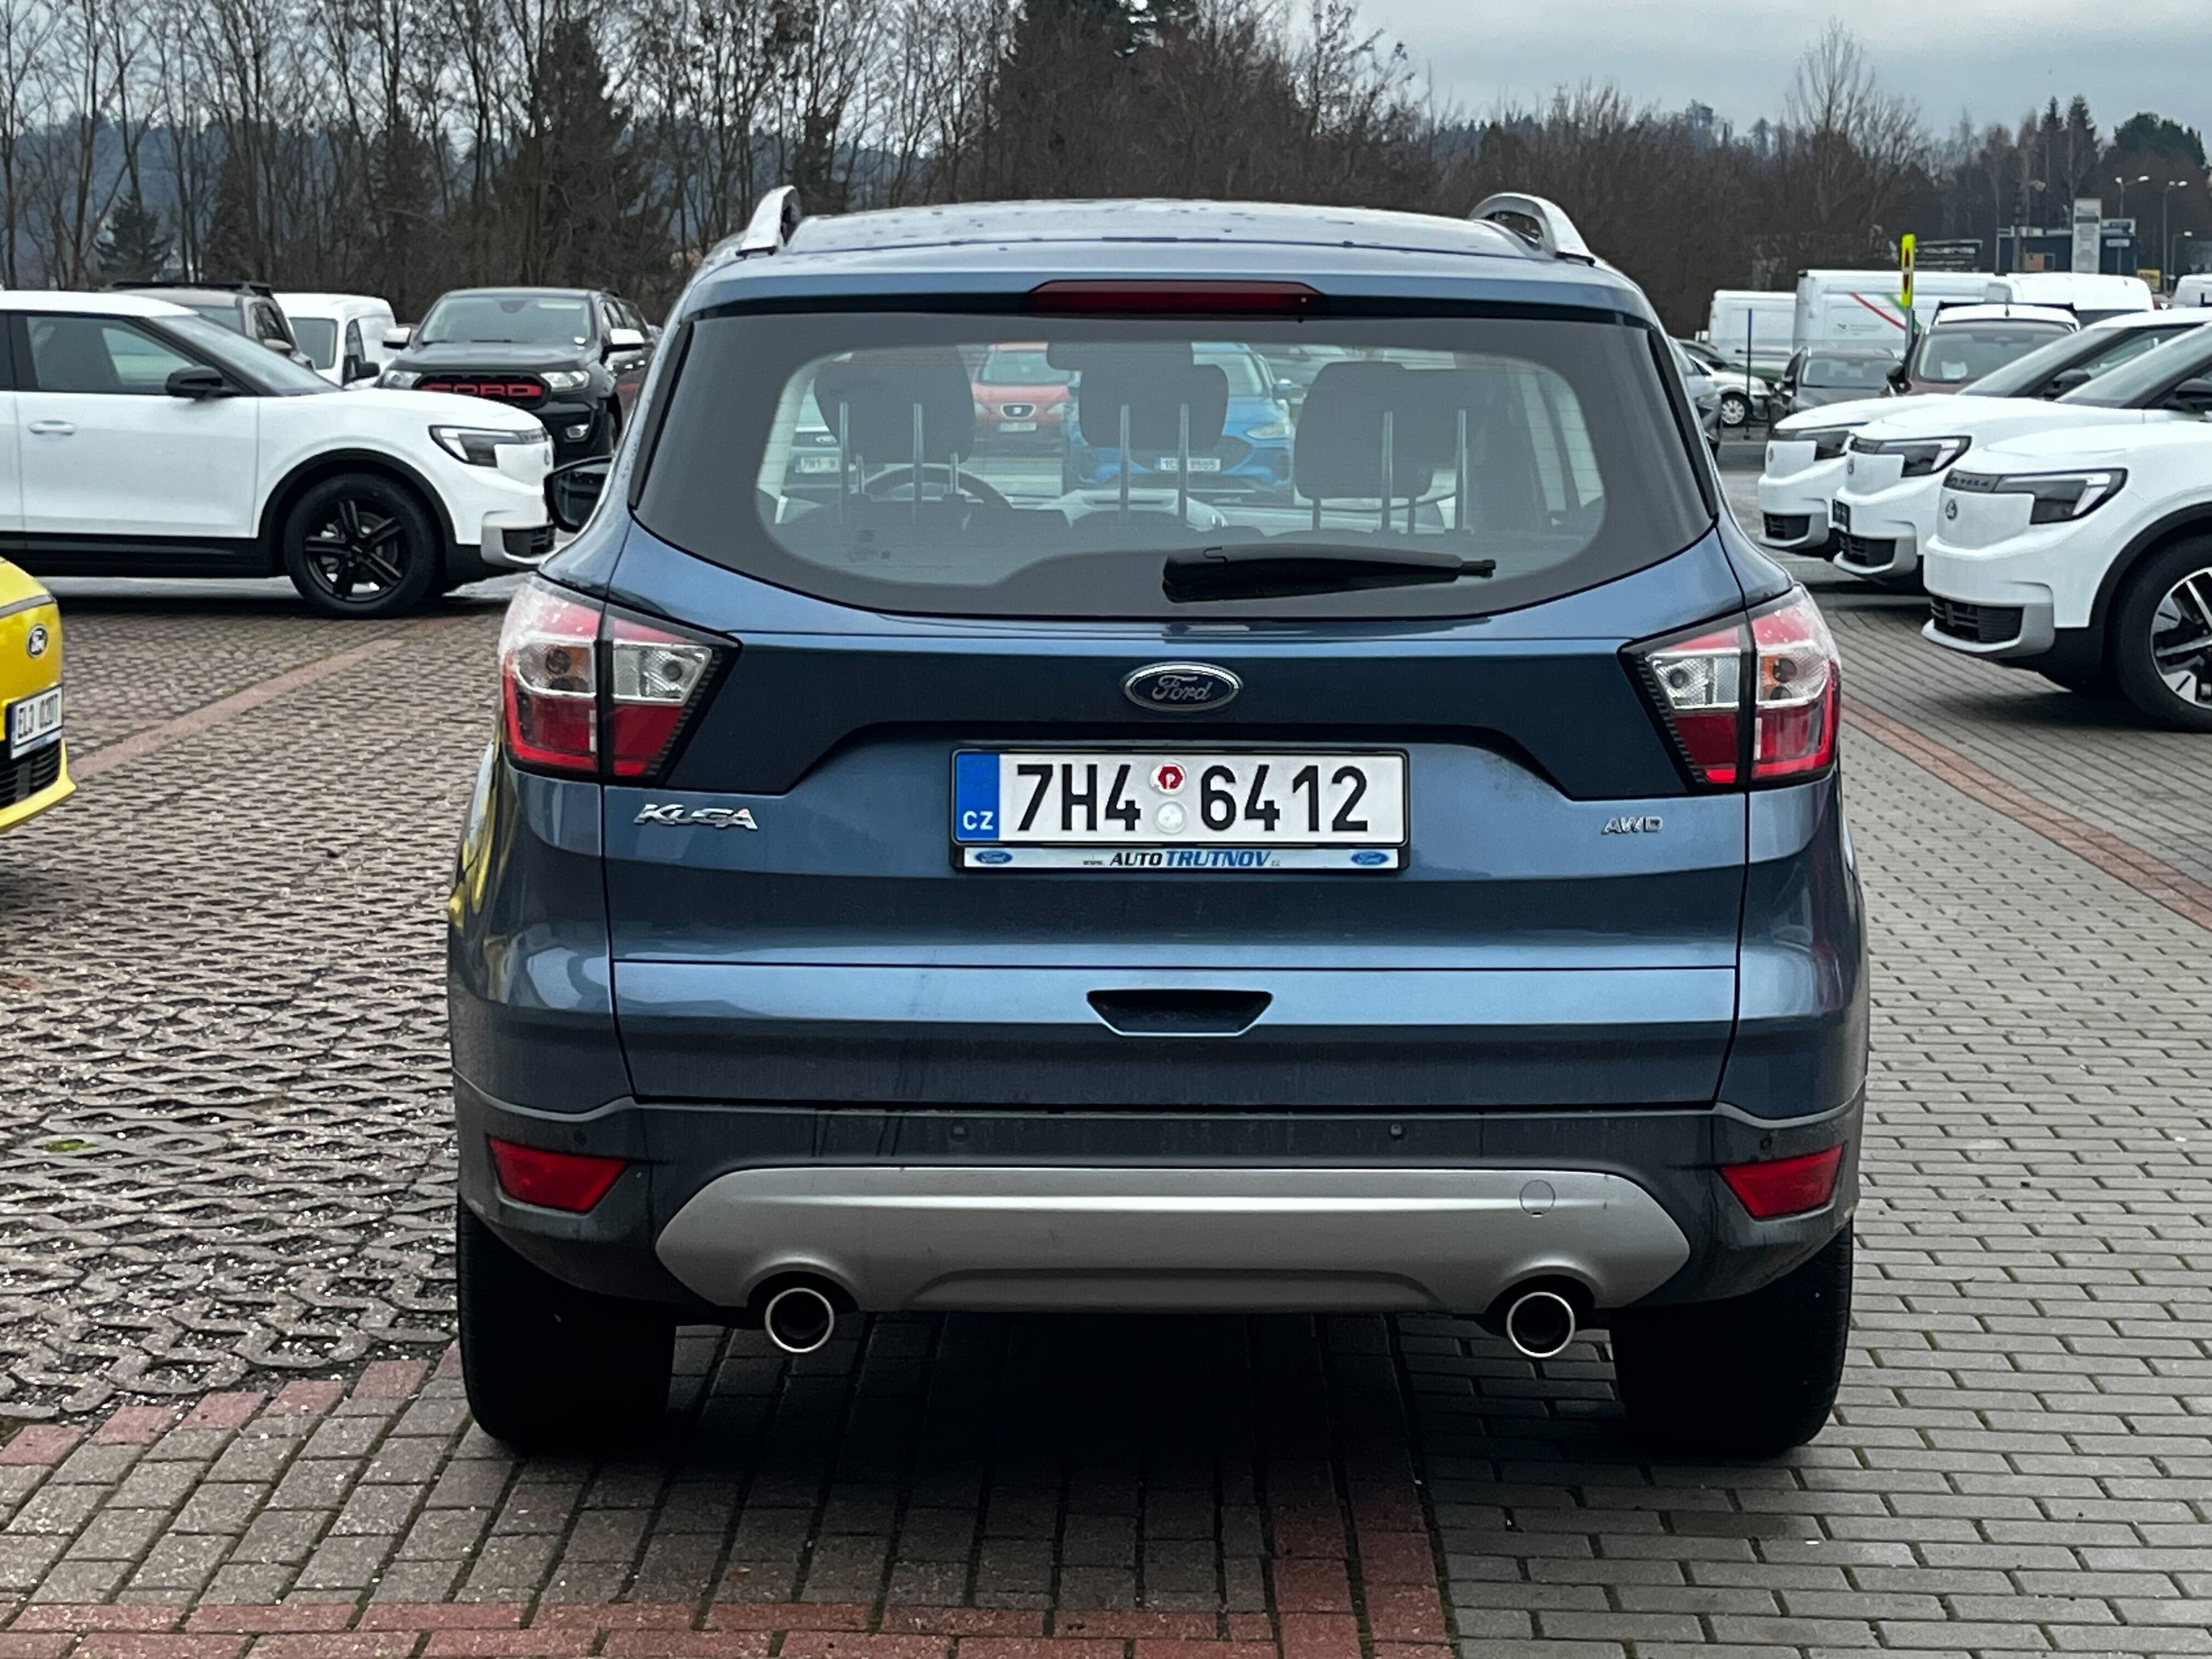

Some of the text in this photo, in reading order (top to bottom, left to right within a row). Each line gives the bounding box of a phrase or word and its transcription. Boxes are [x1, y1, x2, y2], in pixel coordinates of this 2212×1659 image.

[1152, 675, 1214, 700] Ford
[1017, 764, 1368, 832] 7H4 6412
[634, 804, 758, 830] KUGA
[963, 810, 994, 830] CZ
[1602, 816, 1663, 833] AWD
[1166, 851, 1271, 867] TRUTNOV
